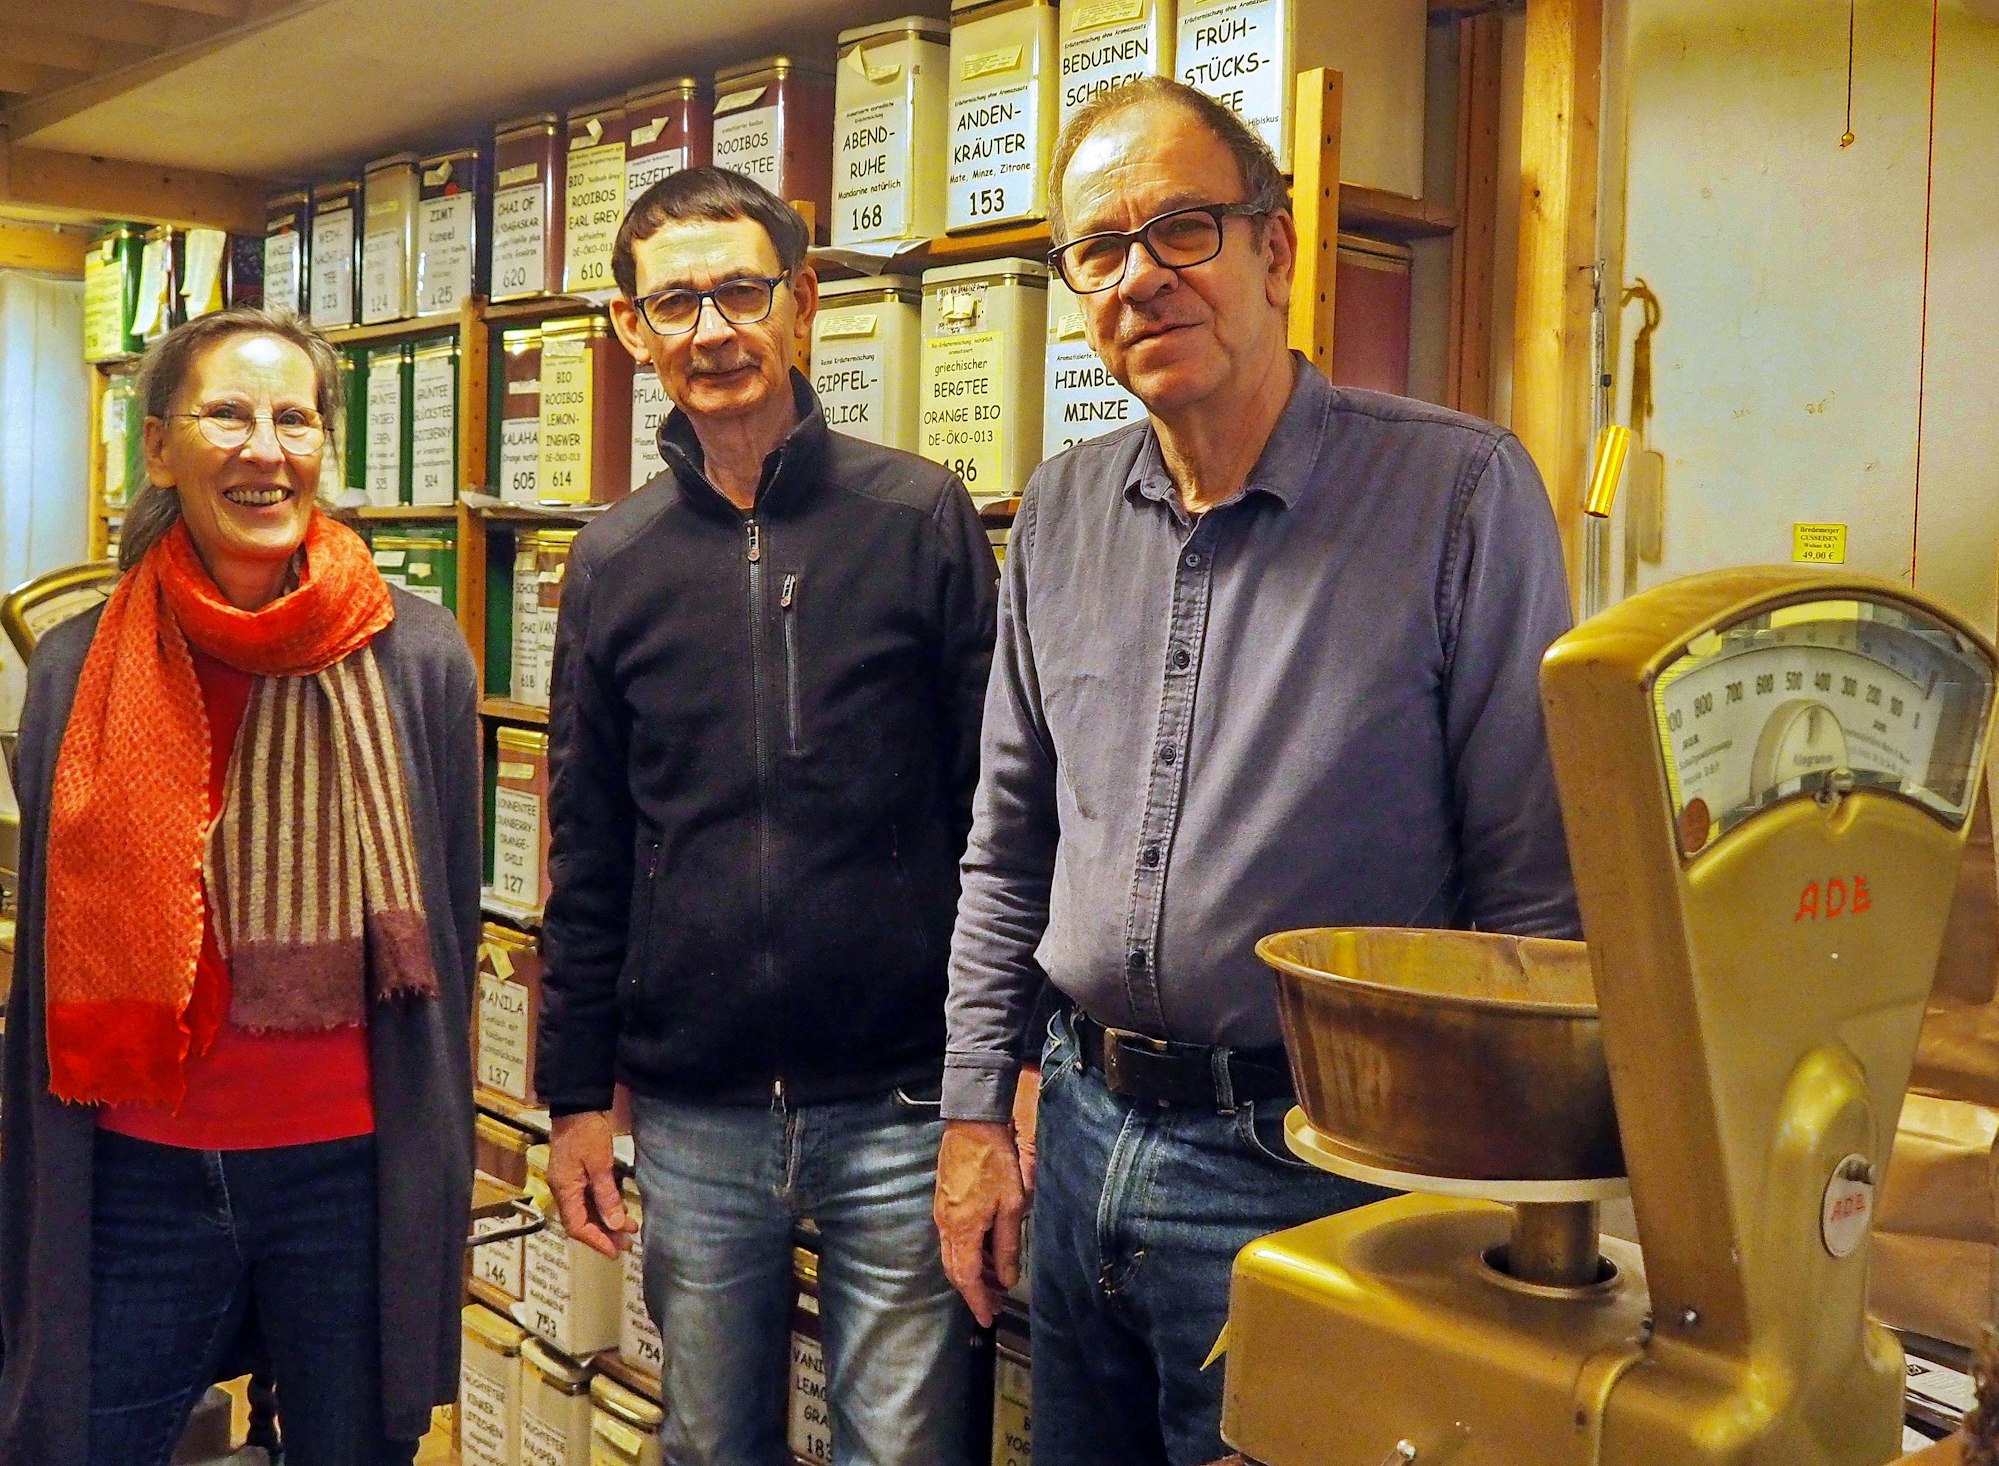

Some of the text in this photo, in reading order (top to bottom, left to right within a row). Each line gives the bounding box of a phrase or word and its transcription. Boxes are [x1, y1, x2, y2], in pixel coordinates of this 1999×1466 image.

[1183, 9, 1224, 25] Kräutermischung
[1225, 5, 1237, 13] ohne
[1195, 17, 1258, 51] FRÜH-
[1062, 37, 1149, 76] BEDUINEN
[1184, 52, 1271, 87] STÜCKS-
[1213, 89, 1244, 112] EE
[956, 102, 1022, 132] ANDEN-
[717, 132, 769, 156] ROOIBOS
[842, 125, 896, 152] ABEND-
[953, 133, 1026, 165] KRÄUTER
[849, 154, 887, 179] RUHE
[949, 161, 1031, 185] Mate, Minze, Zitrone
[568, 173, 585, 188] BIO
[837, 179, 901, 200] Mandarine natürlich
[521, 196, 536, 211] OF
[571, 189, 617, 208] ROOIBOS
[969, 187, 1005, 216] 153
[429, 206, 454, 223] ZIMT
[568, 208, 621, 230] EARL GREY
[851, 204, 883, 231] 168
[502, 267, 527, 288] 620
[581, 261, 604, 280] 610
[431, 285, 454, 306] 125
[556, 371, 573, 384] BIO
[933, 358, 988, 377] griechischer
[816, 370, 878, 395] GIPFEL-
[933, 378, 988, 399] BERGTEE
[545, 391, 584, 406] ROOIBOS
[546, 412, 580, 426] LEMON-
[823, 403, 869, 425] BLICK
[923, 404, 1001, 425] ORANGE BIO
[1063, 399, 1129, 423] MINZE
[546, 433, 581, 447] INGWER
[928, 429, 993, 447] DE-ÖKO-013
[424, 474, 439, 488] 524
[513, 471, 536, 490] 605
[552, 470, 573, 487] 614
[1828, 551, 1835, 560] €
[1785, 671, 1803, 691] 500
[1814, 671, 1832, 692] 400
[1725, 680, 1745, 705] 700
[1693, 691, 1713, 719] 800
[498, 797, 537, 817] ONNENTEE
[504, 872, 524, 894] 127
[1793, 875, 1873, 923] ADE
[480, 985, 525, 1016] ANILA
[489, 1064, 510, 1088] 137
[485, 1260, 507, 1286] 146
